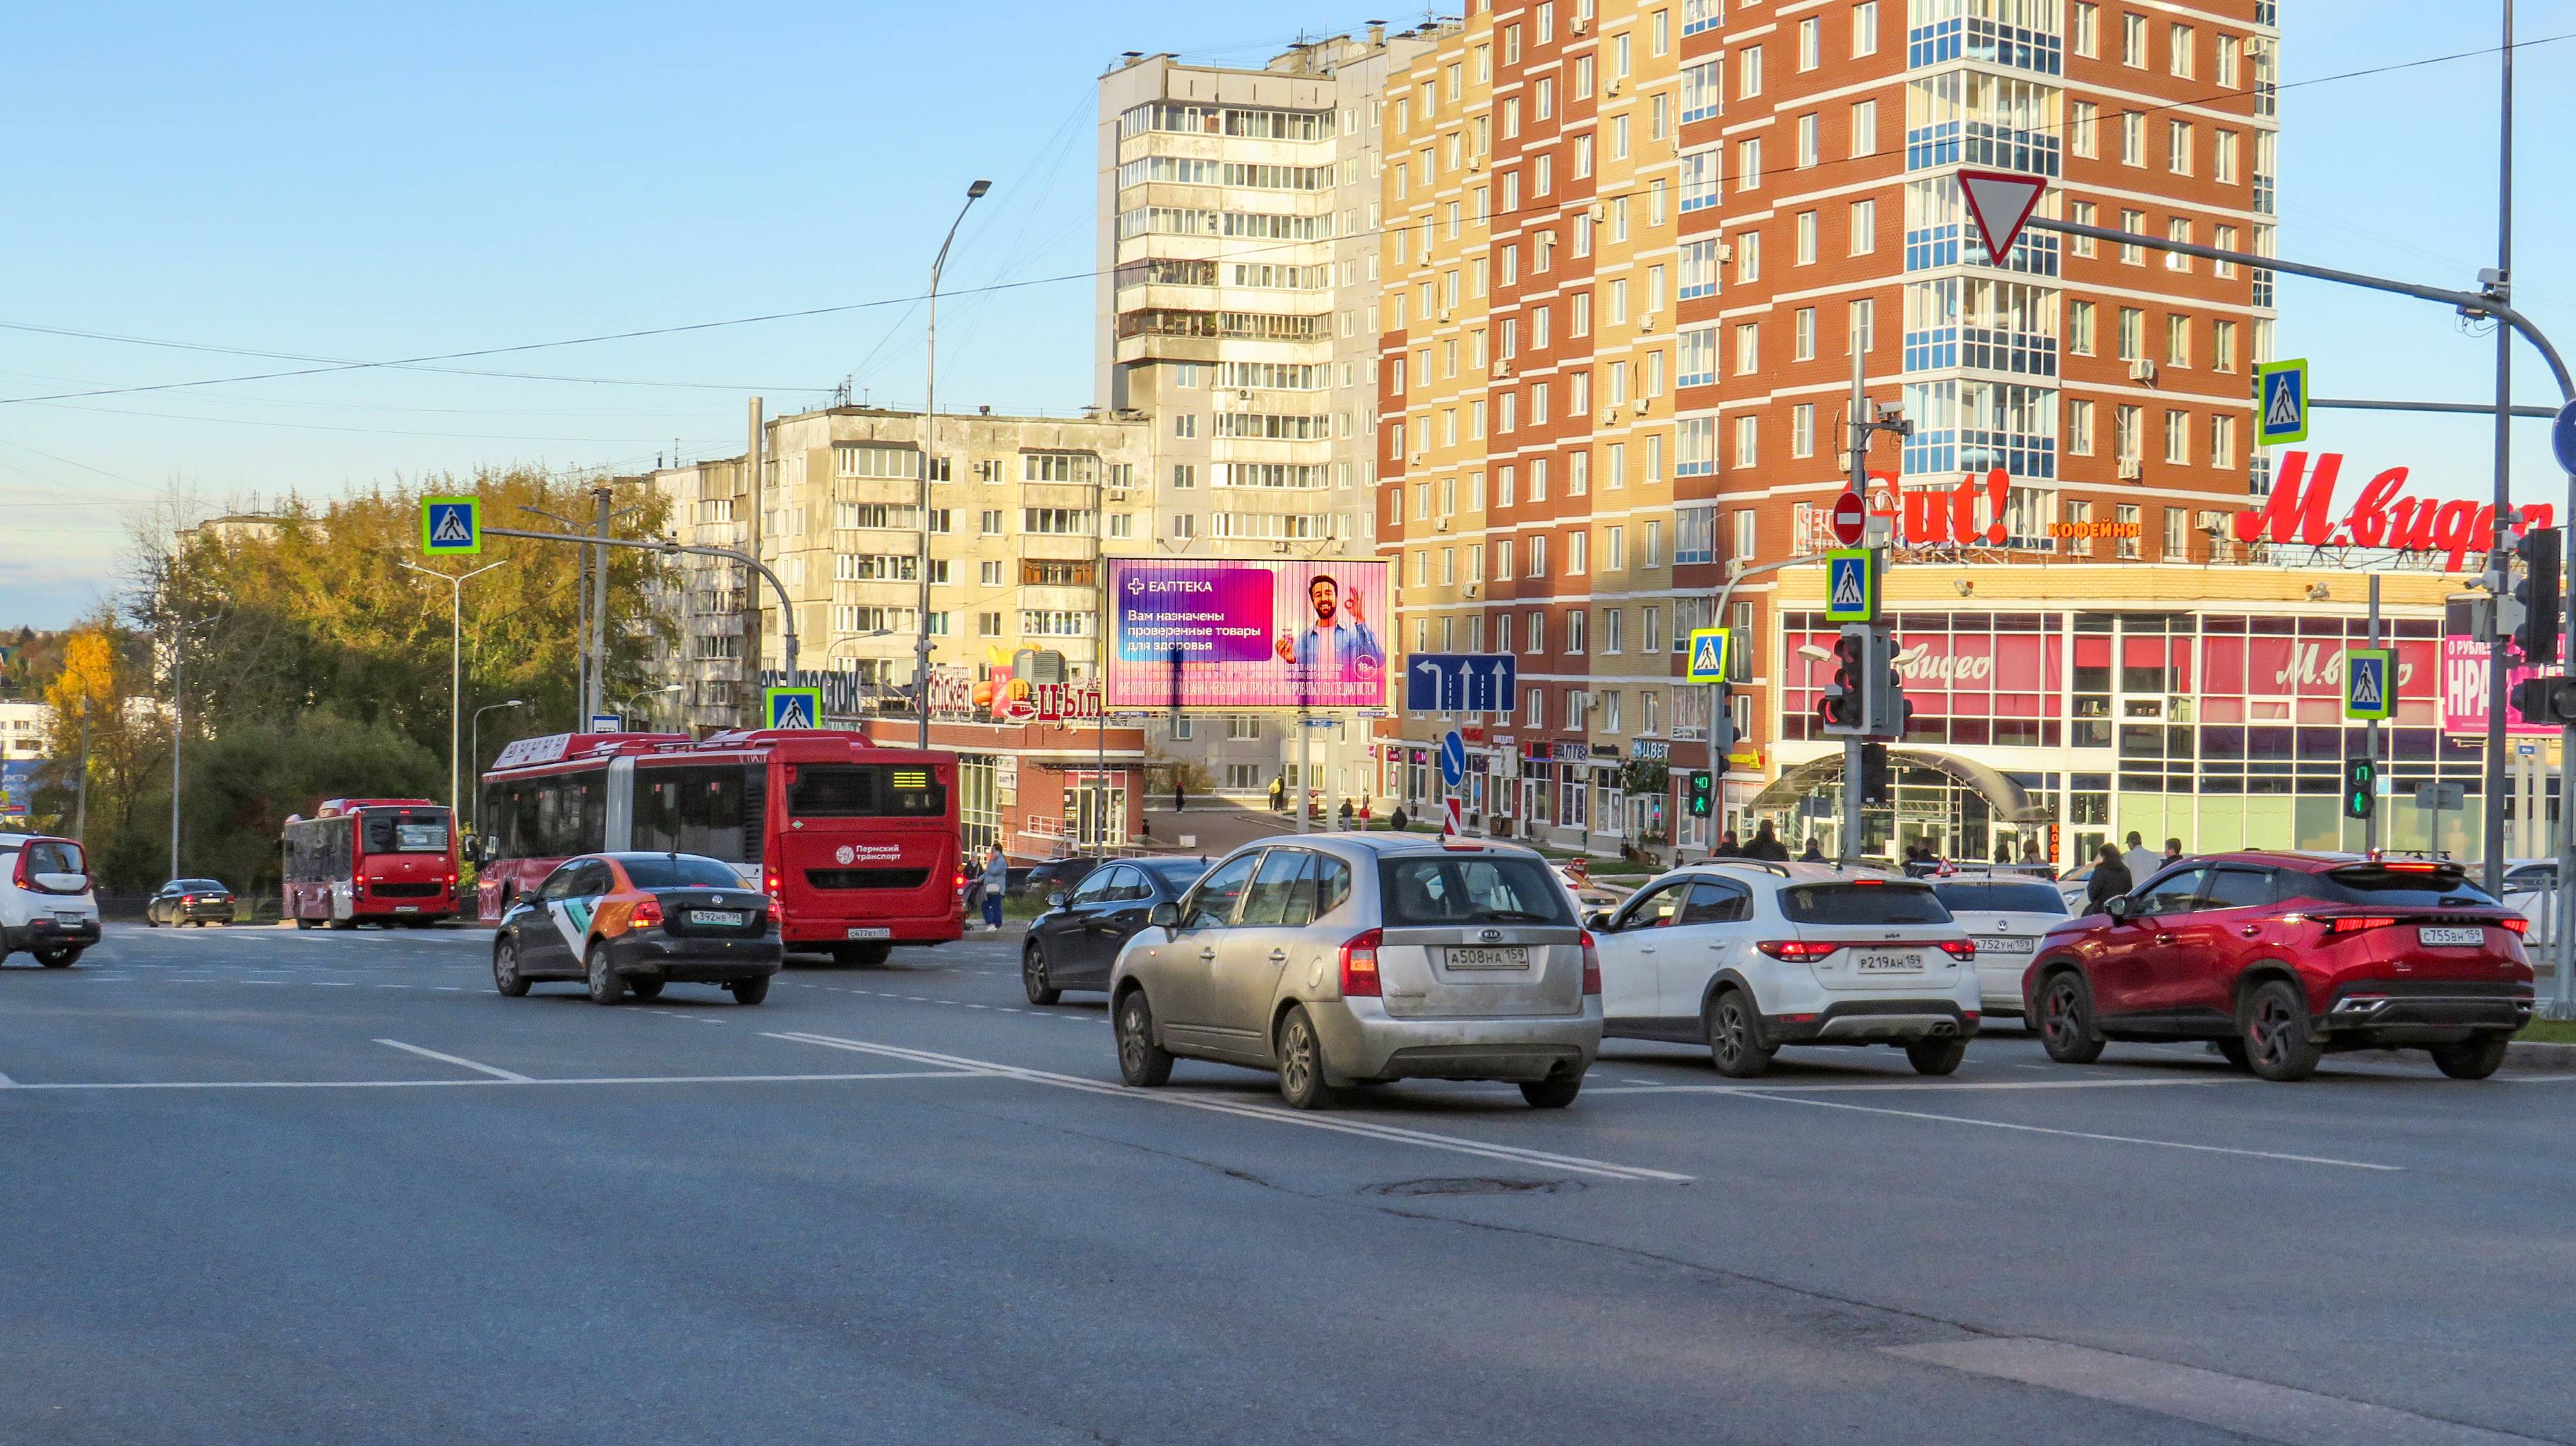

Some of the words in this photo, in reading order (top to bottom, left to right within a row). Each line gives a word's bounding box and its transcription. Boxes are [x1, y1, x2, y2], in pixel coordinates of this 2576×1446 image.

[2049, 518, 2139, 540] КОФЕЙНЯ
[1149, 581, 1212, 592] ЕАПТЕКА
[1128, 610, 1153, 621] Вам
[1157, 611, 1224, 621] назначены
[1128, 627, 1212, 638] проверенные
[1215, 627, 1260, 638] товары
[1127, 642, 1150, 652] для
[1154, 641, 1212, 652] здоровья
[1902, 643, 1991, 688] видео
[1559, 744, 1587, 760] АПТЕ
[1695, 777, 1708, 789] 40
[857, 844, 900, 853] Пермский
[857, 853, 901, 861] транспорт
[2423, 930, 2464, 942] С755ВН
[2465, 929, 2480, 940] 159
[2015, 940, 2030, 948] 159
[1451, 950, 1502, 964] А508НА
[1504, 948, 1524, 960] 159
[1861, 957, 1904, 969] Р219АН
[1907, 955, 1921, 965] 159
